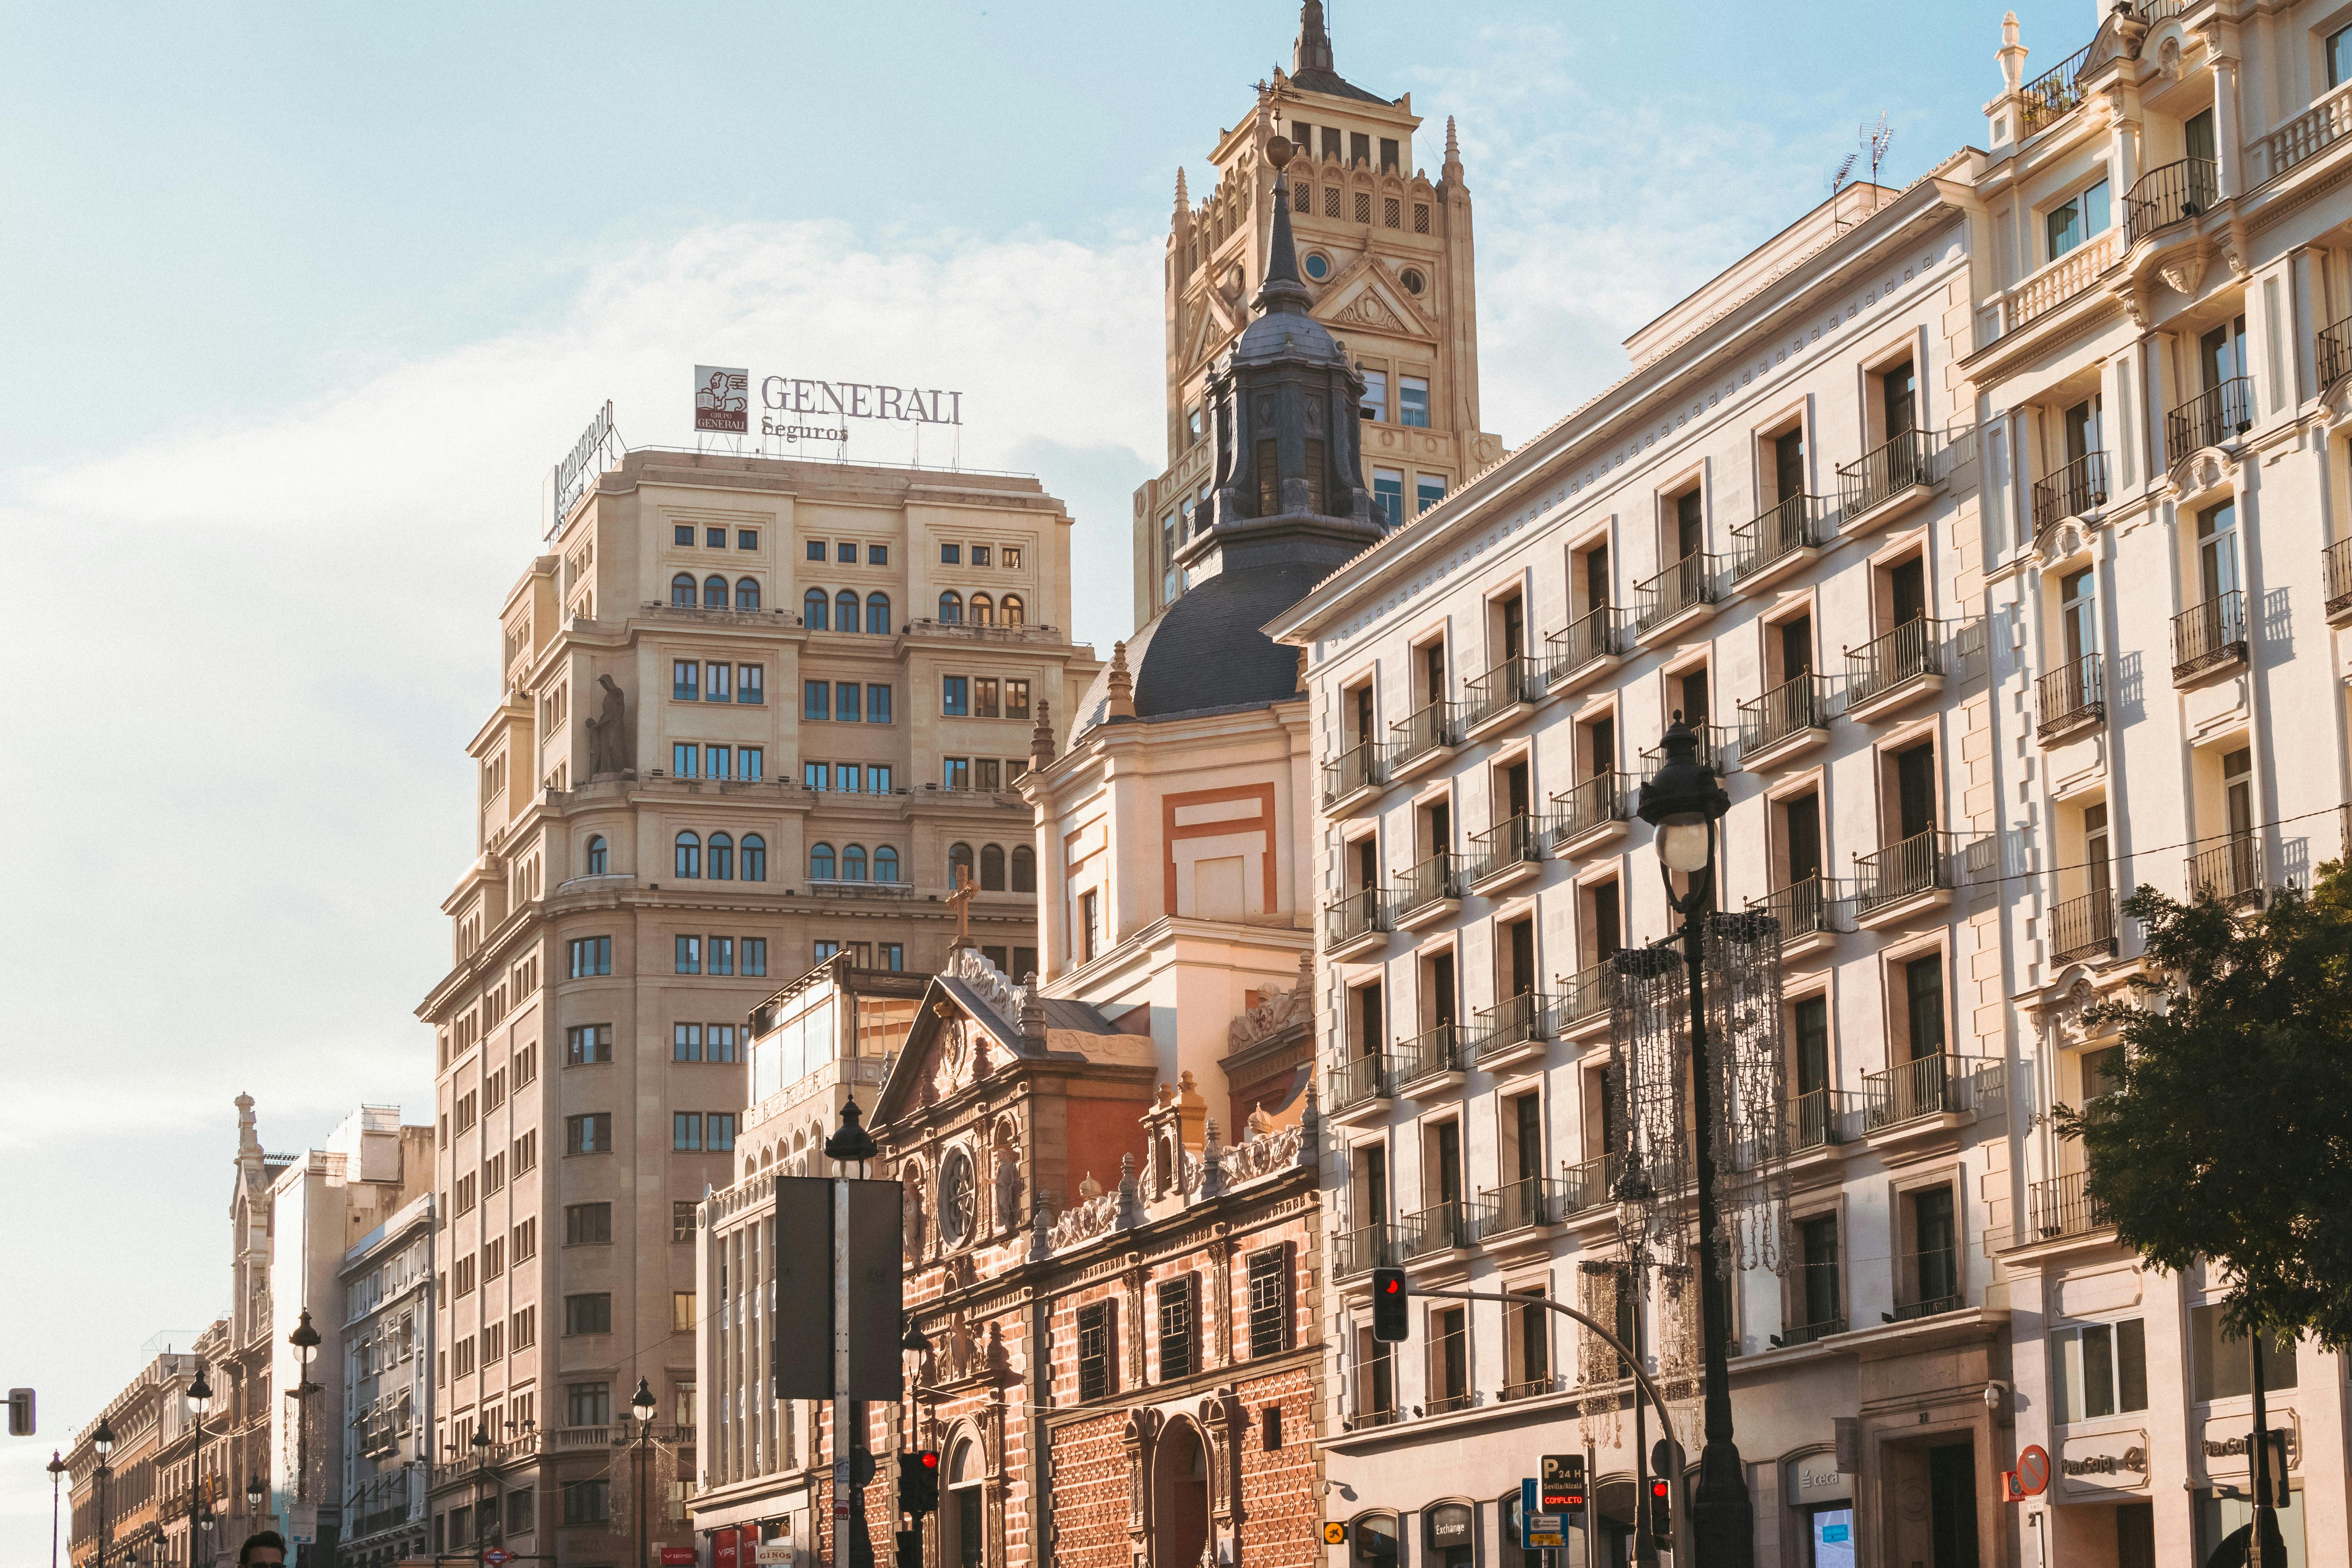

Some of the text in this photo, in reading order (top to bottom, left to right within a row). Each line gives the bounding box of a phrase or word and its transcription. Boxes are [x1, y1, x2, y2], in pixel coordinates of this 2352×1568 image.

[762, 376, 963, 425] GENERALI
[698, 418, 745, 430] GENERALI
[761, 416, 848, 443] Seguros
[2201, 1435, 2248, 1455] iberCaj
[1544, 1459, 1581, 1479] P 24 H
[2060, 1454, 2112, 1473] iberCaja
[1813, 1473, 1838, 1486] ceca
[1436, 1524, 1465, 1535] Exchange
[718, 1547, 735, 1556] VIPS
